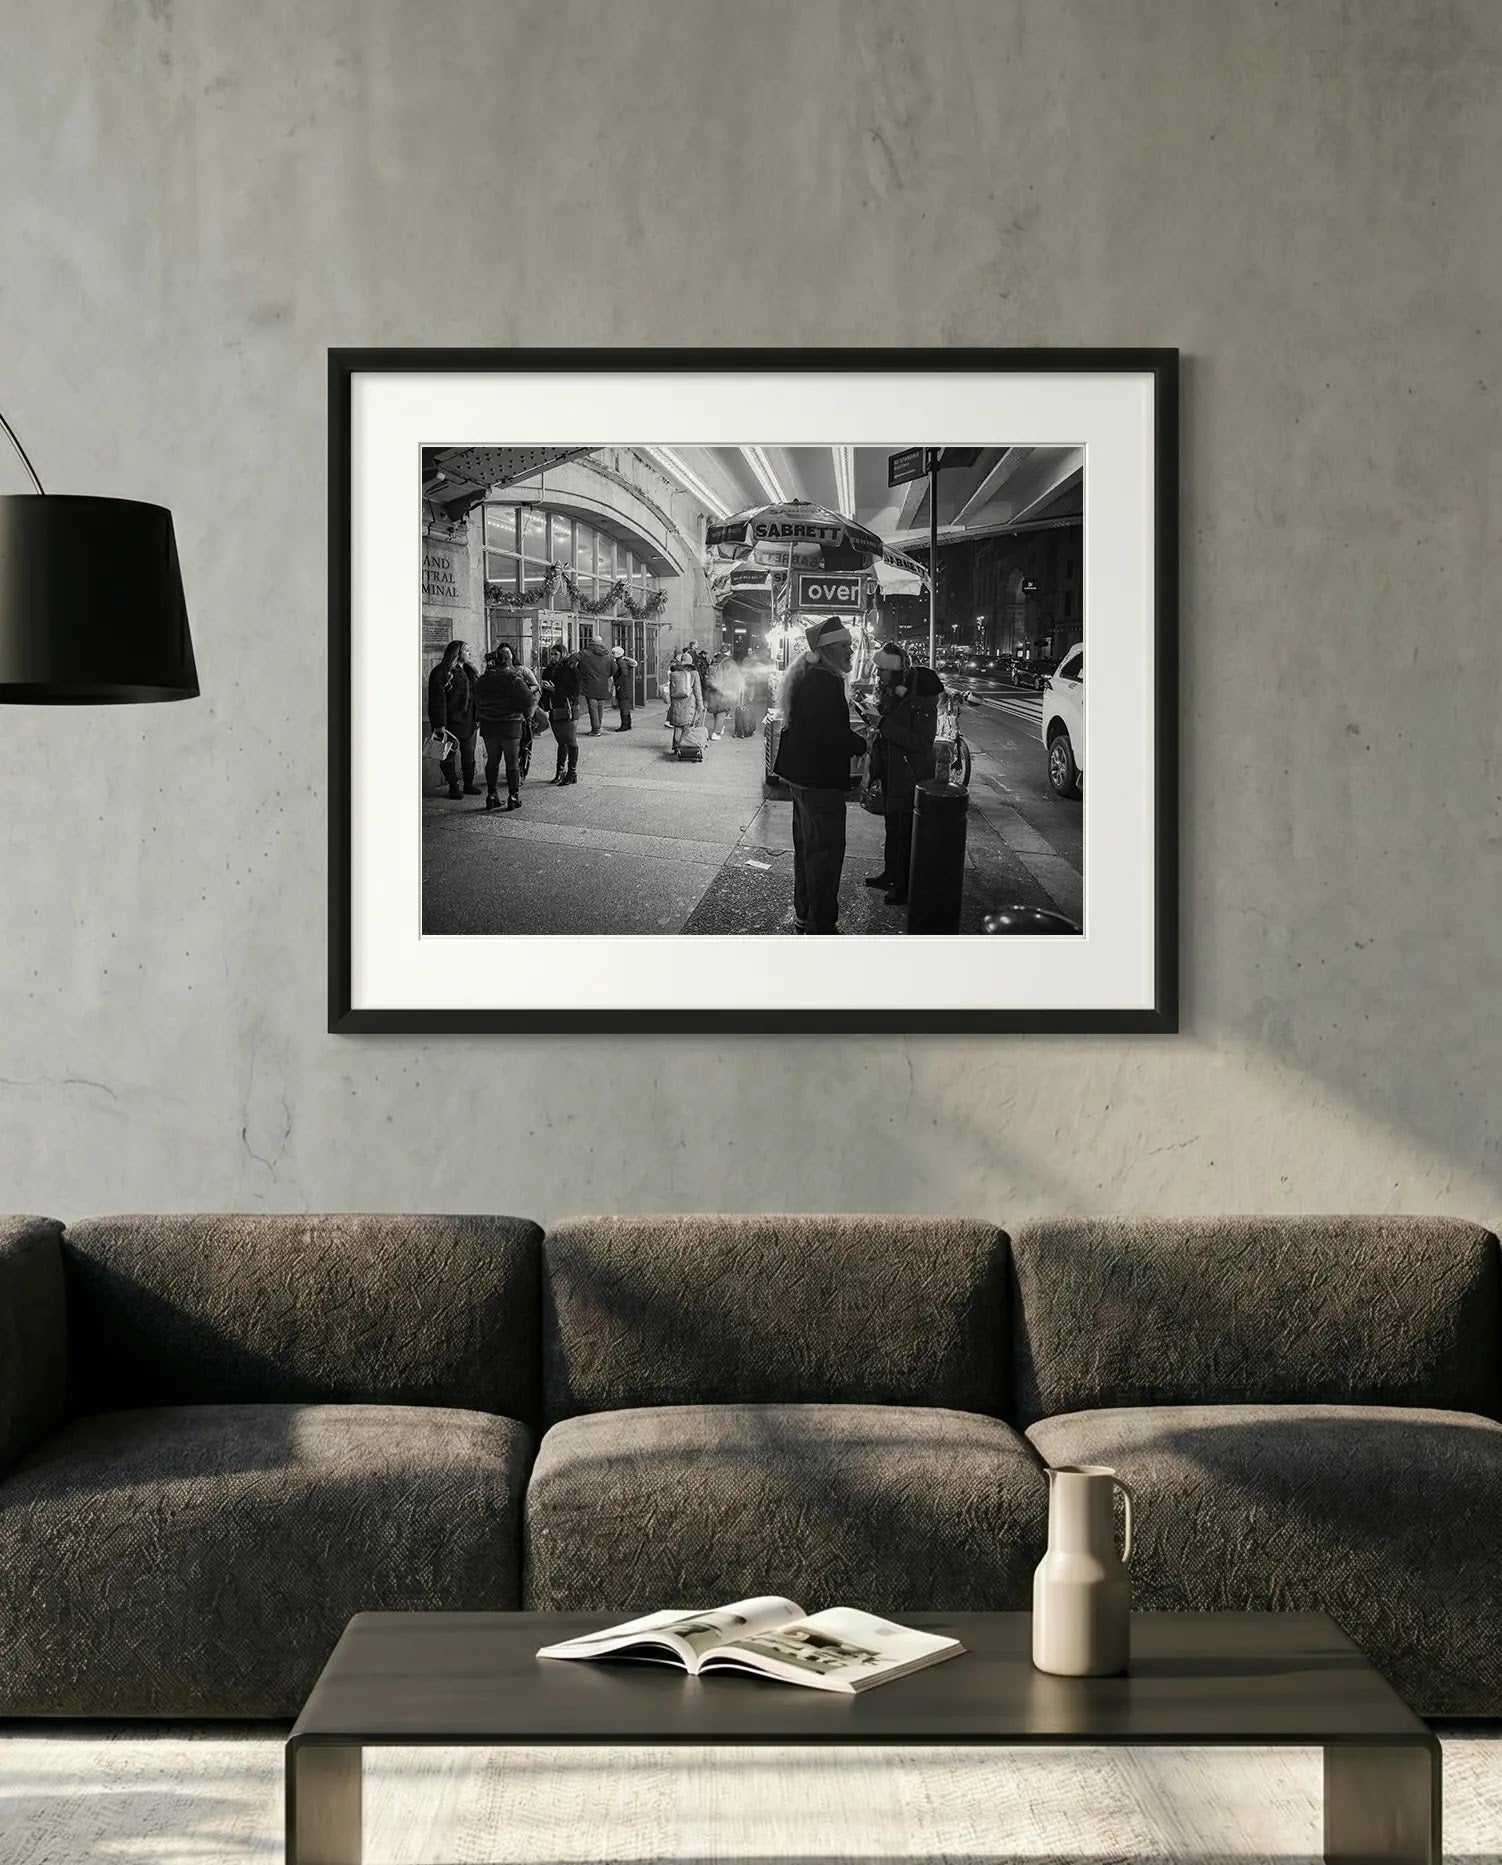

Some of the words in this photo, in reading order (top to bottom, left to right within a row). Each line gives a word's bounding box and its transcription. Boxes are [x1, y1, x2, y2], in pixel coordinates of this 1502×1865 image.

[755, 523, 841, 540] SABRETT
[422, 569, 455, 584] TRAL
[808, 584, 859, 601] over
